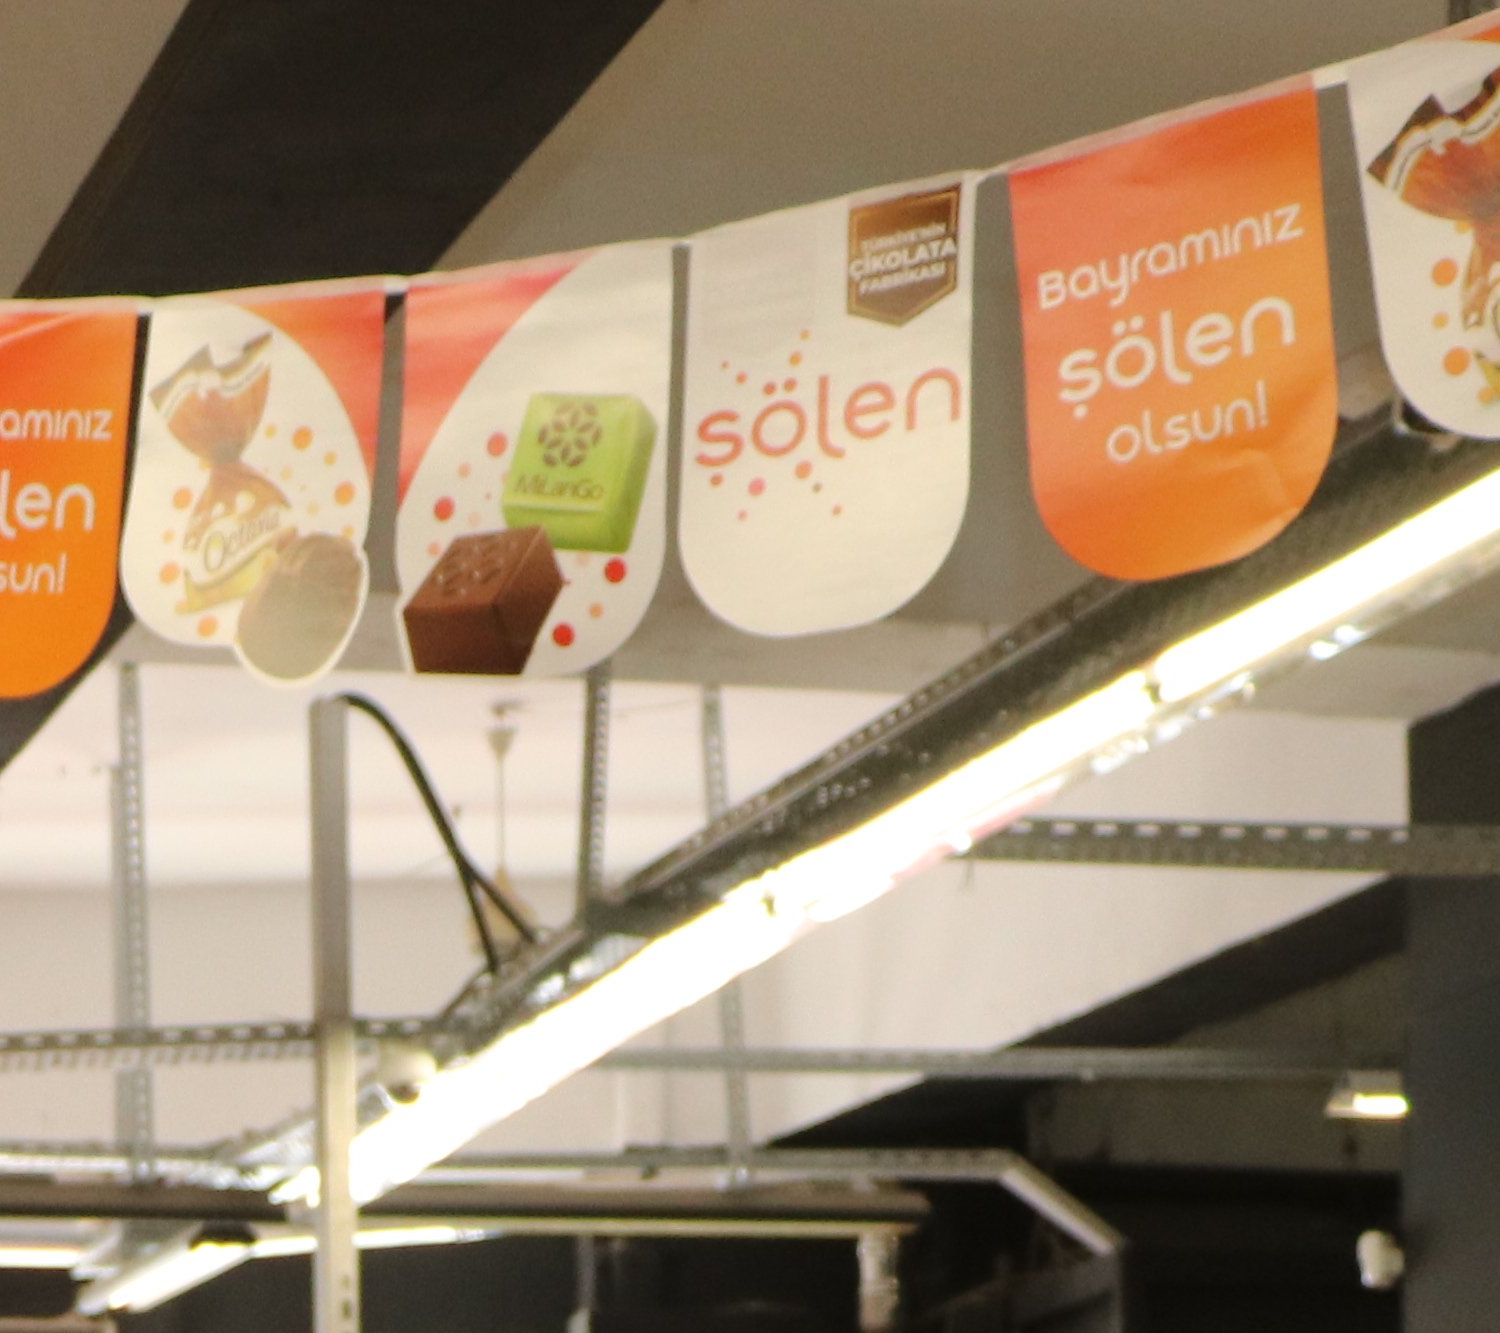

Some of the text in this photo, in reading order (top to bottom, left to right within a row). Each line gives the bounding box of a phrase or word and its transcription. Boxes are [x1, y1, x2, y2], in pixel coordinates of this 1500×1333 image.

[1037, 204, 1303, 311] Bayramınız
[1057, 296, 1297, 420] şölen
[1107, 381, 1267, 463] olsun!
